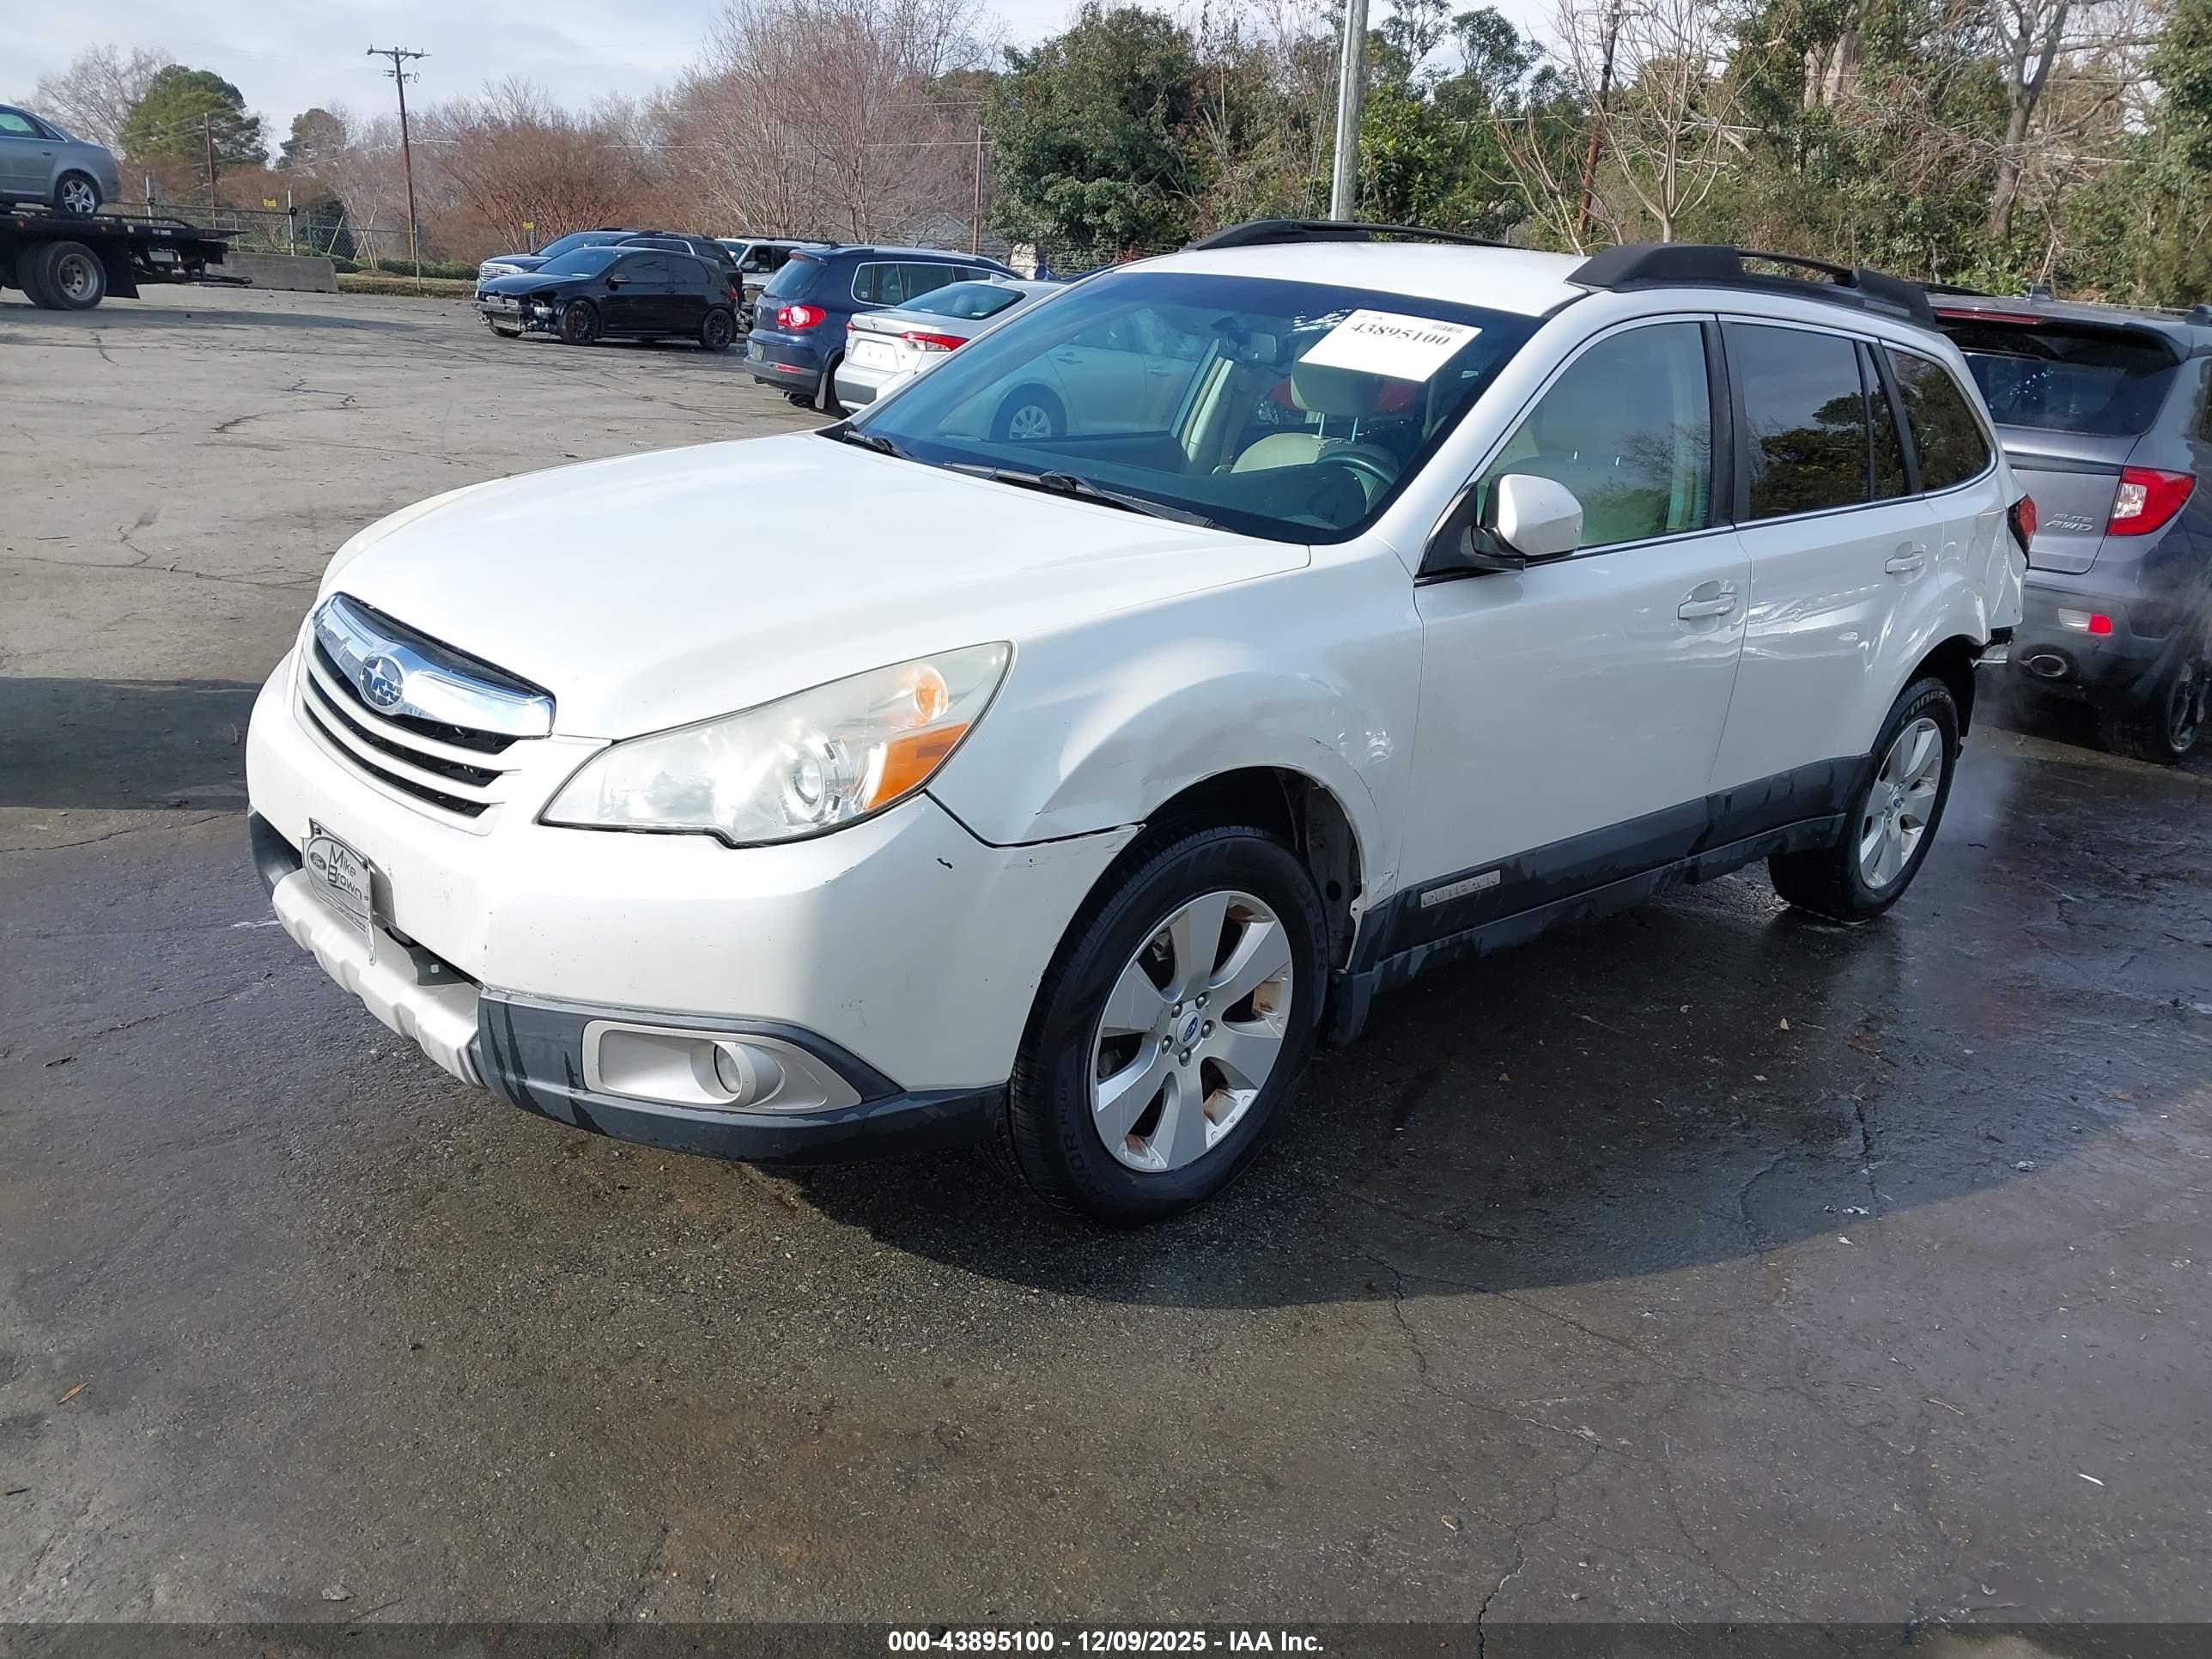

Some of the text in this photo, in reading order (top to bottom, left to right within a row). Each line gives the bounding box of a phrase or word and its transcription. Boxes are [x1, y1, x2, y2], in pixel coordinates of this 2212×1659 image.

[1351, 321, 1450, 347] 43895100
[2044, 520, 2094, 532] AWD
[329, 842, 356, 878] Mike
[327, 864, 362, 901] Brown
